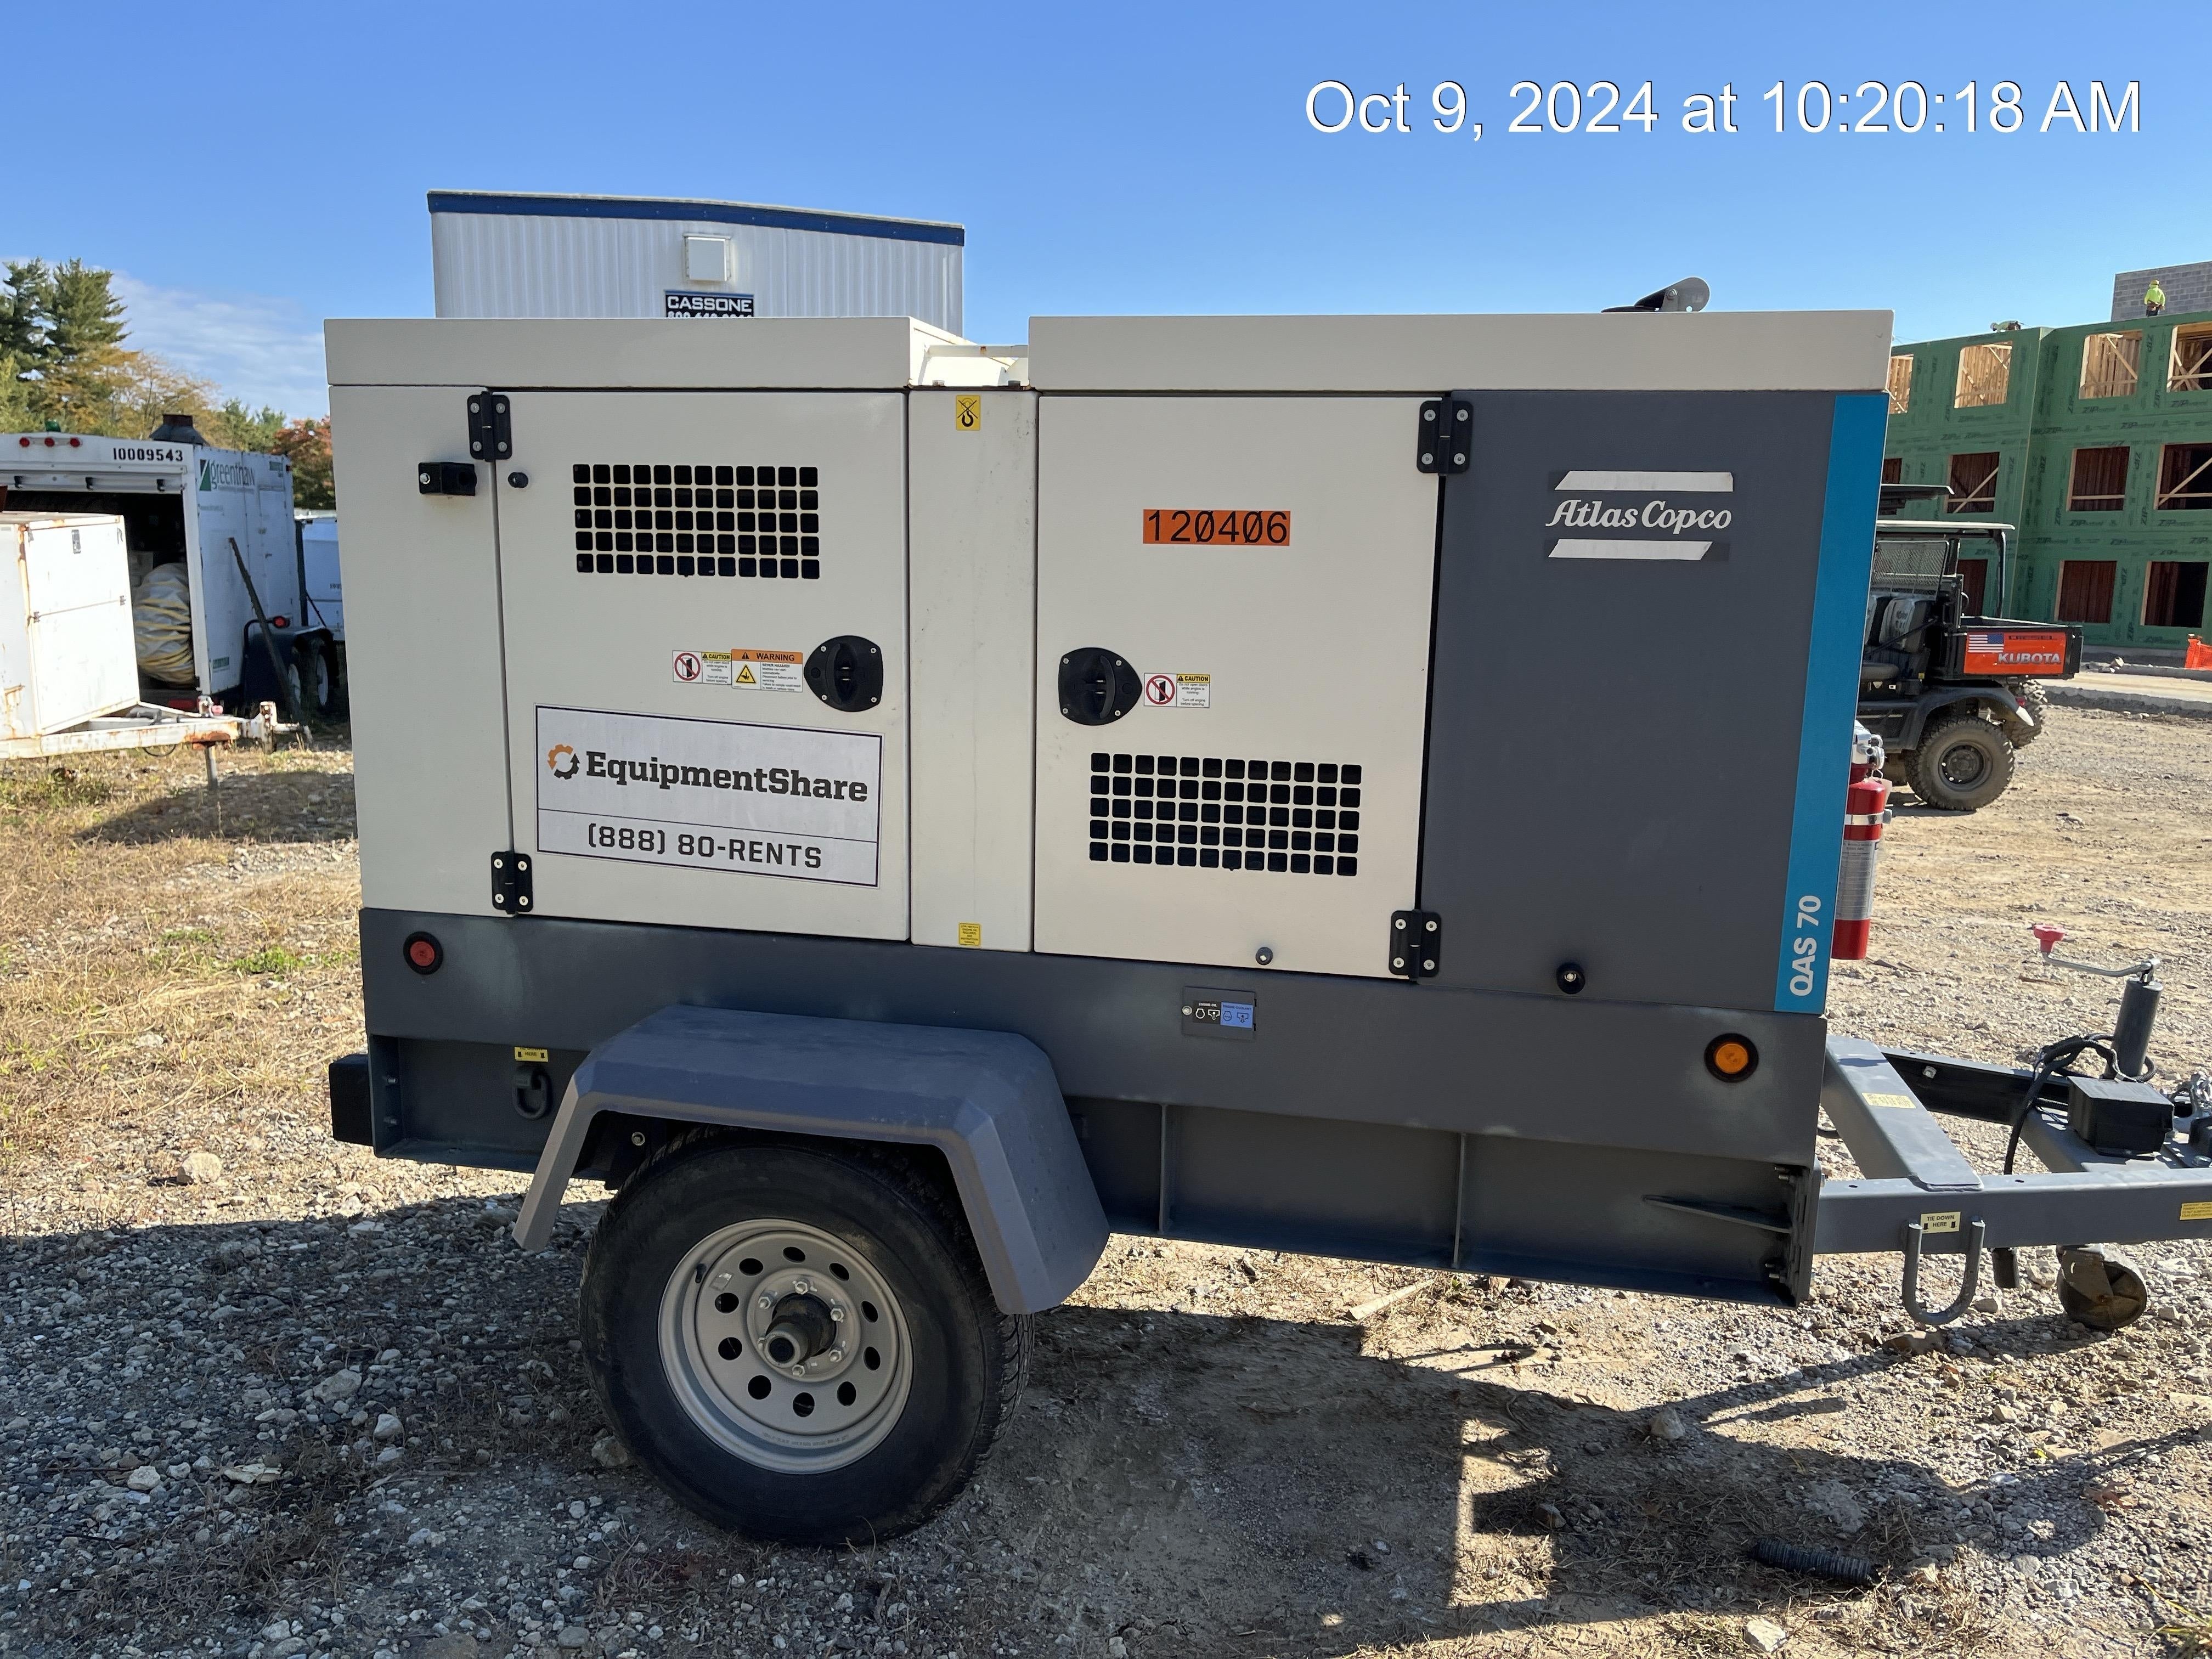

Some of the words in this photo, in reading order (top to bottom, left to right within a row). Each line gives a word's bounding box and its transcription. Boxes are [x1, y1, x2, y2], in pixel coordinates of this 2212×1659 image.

[667, 296, 752, 313] CASSONE
[113, 447, 183, 461] 10009543
[1148, 510, 1288, 543] 120406
[1545, 499, 1639, 528] Atlas
[1641, 500, 1733, 535] Copco
[755, 652, 795, 662] WARNING
[1997, 652, 2061, 664] KUBOTA
[586, 751, 868, 802] EquipmentShare
[588, 822, 665, 855] (888)
[678, 834, 822, 868] 80-RENTS
[1796, 895, 1821, 928] 70
[1790, 937, 1817, 996] QAS
